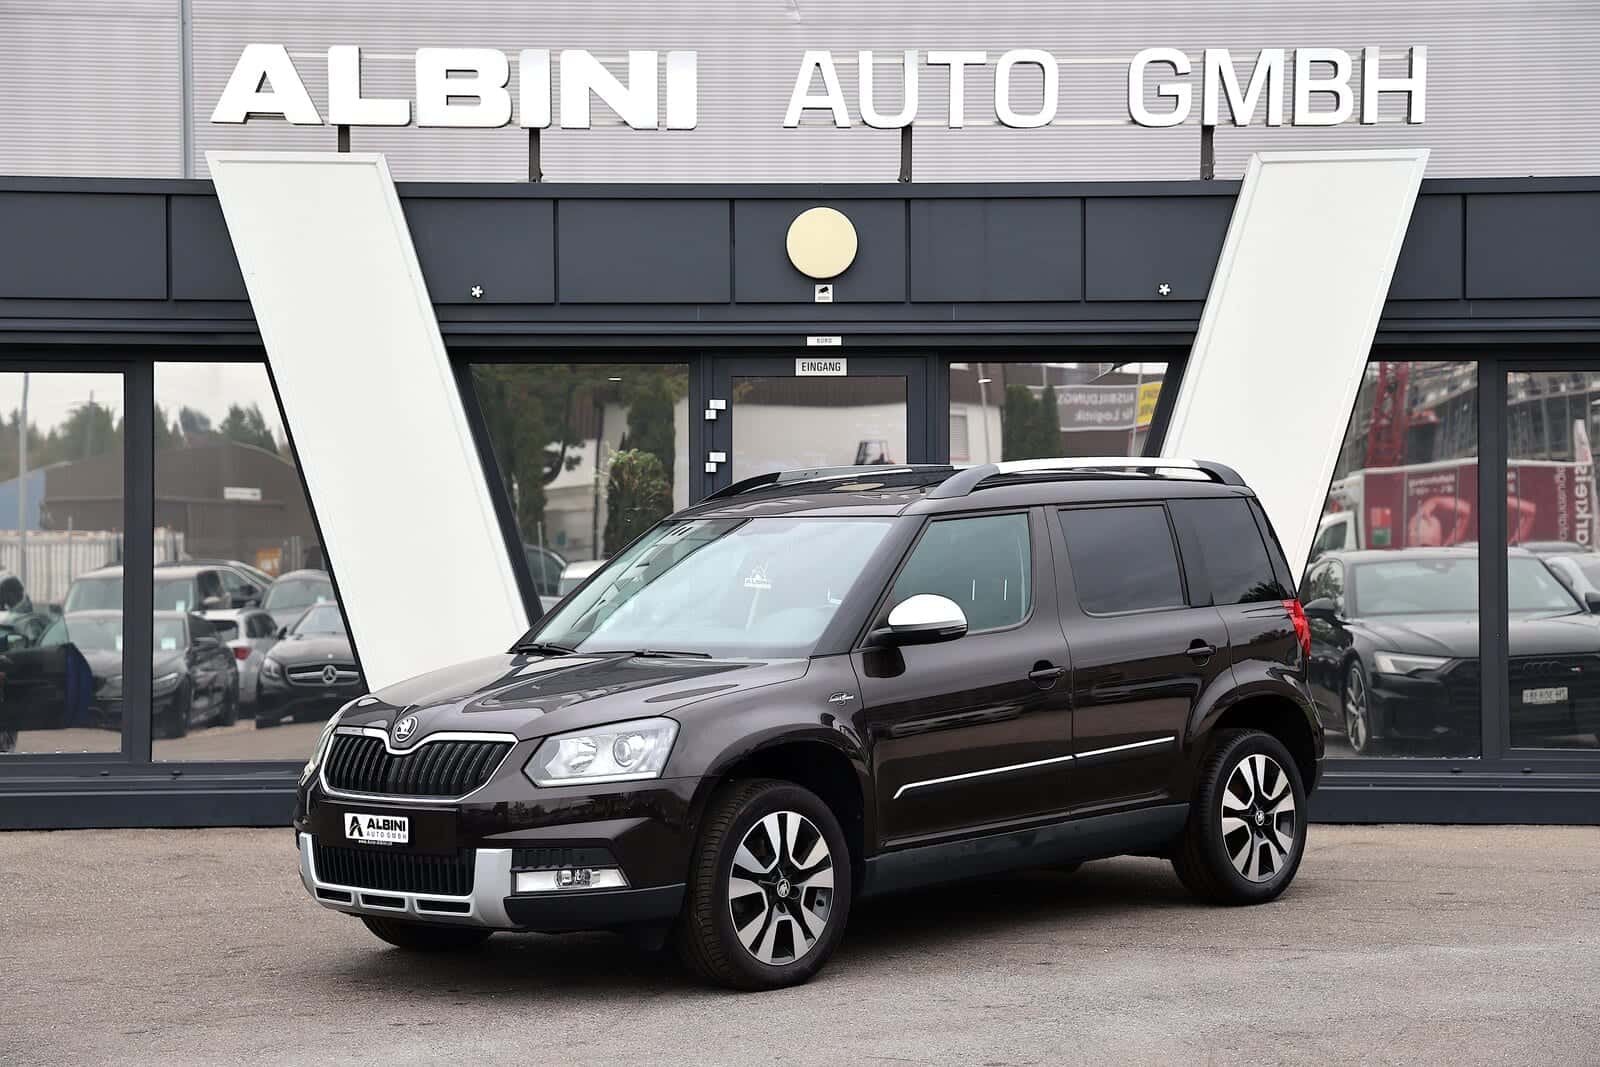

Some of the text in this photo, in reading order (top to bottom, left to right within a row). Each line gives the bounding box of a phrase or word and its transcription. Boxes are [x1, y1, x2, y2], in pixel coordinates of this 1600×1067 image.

[210, 43, 1428, 130] ALBINI AUTO GMBH
[801, 361, 841, 372] EINGANG
[367, 818, 406, 832] ALBINI
